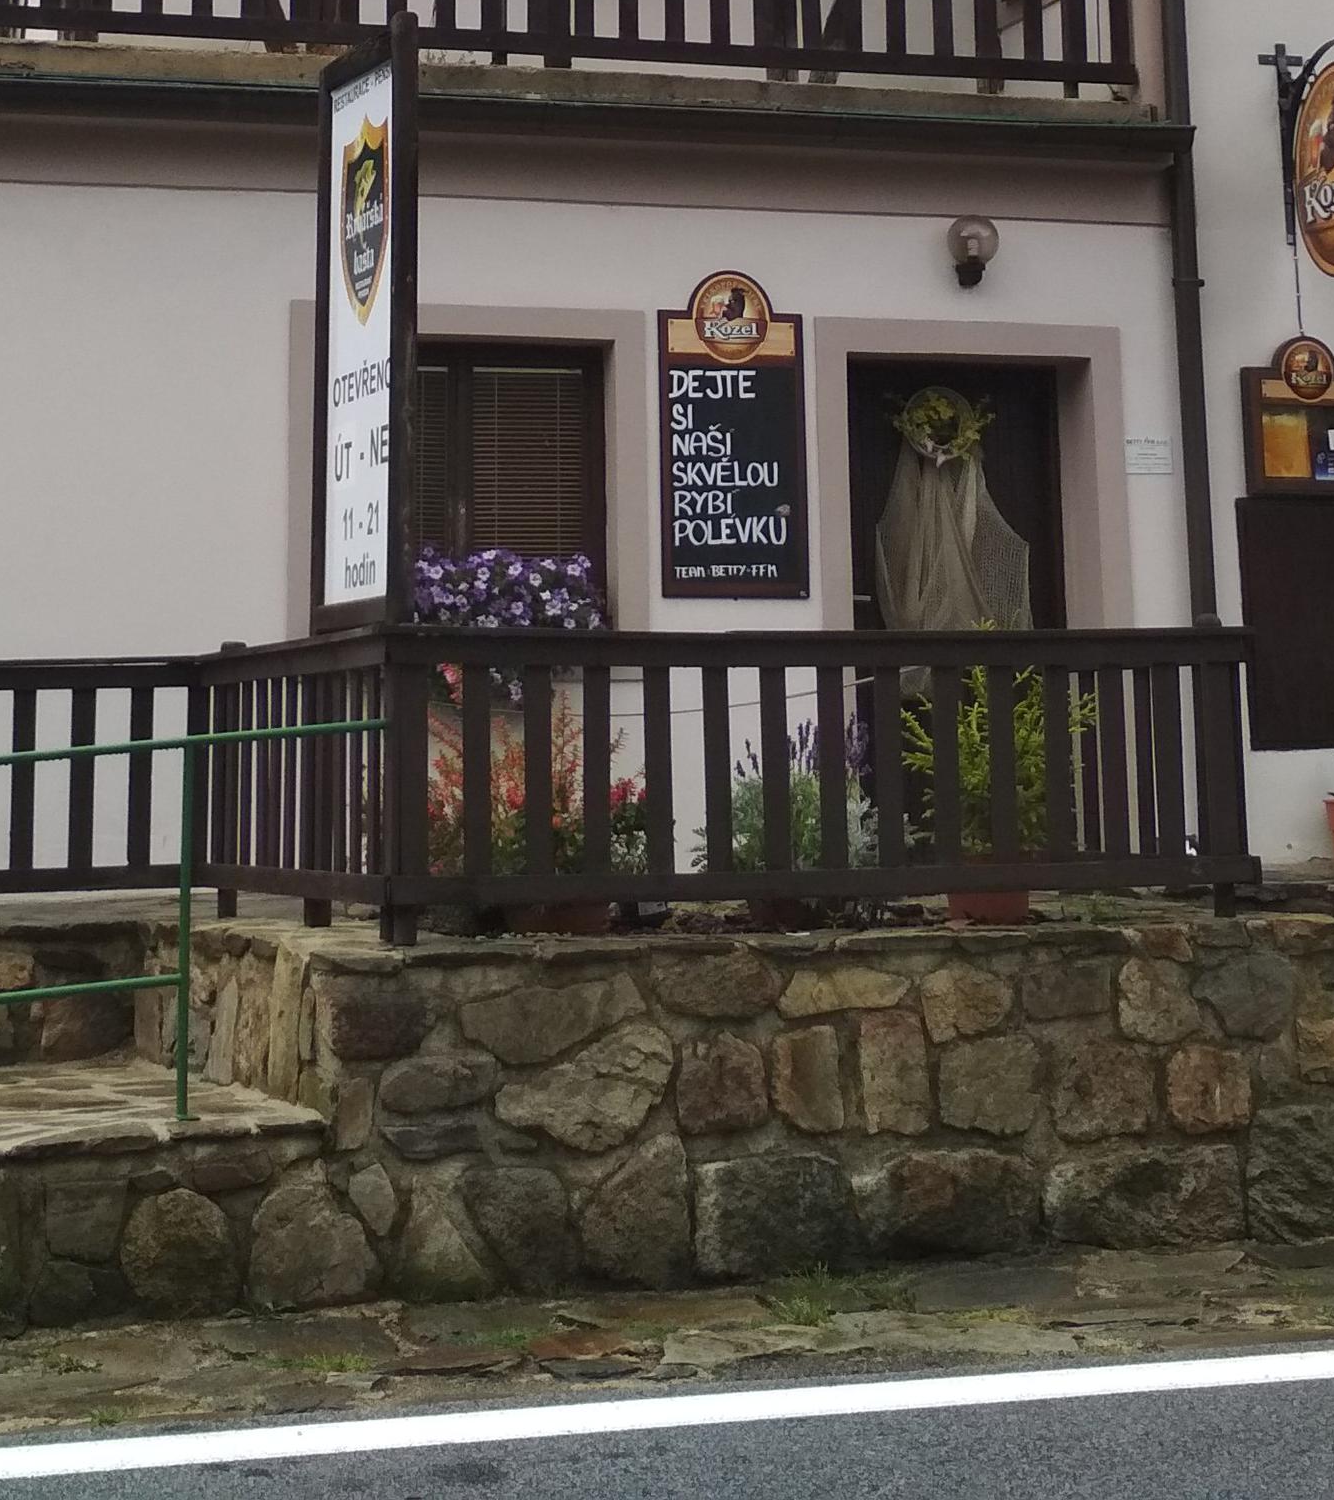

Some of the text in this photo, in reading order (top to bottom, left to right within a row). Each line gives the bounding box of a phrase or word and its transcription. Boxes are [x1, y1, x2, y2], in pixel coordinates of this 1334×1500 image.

[703, 318, 761, 341] Kozel
[669, 369, 757, 399] DEJTE
[670, 403, 693, 431] SI
[334, 432, 353, 482] ÚT
[370, 423, 389, 468] NE
[672, 456, 779, 488] SKVĚLOU
[343, 507, 353, 541] 11
[367, 500, 379, 535] 21
[673, 513, 788, 547] POLÉVKU
[344, 551, 376, 589] hodin
